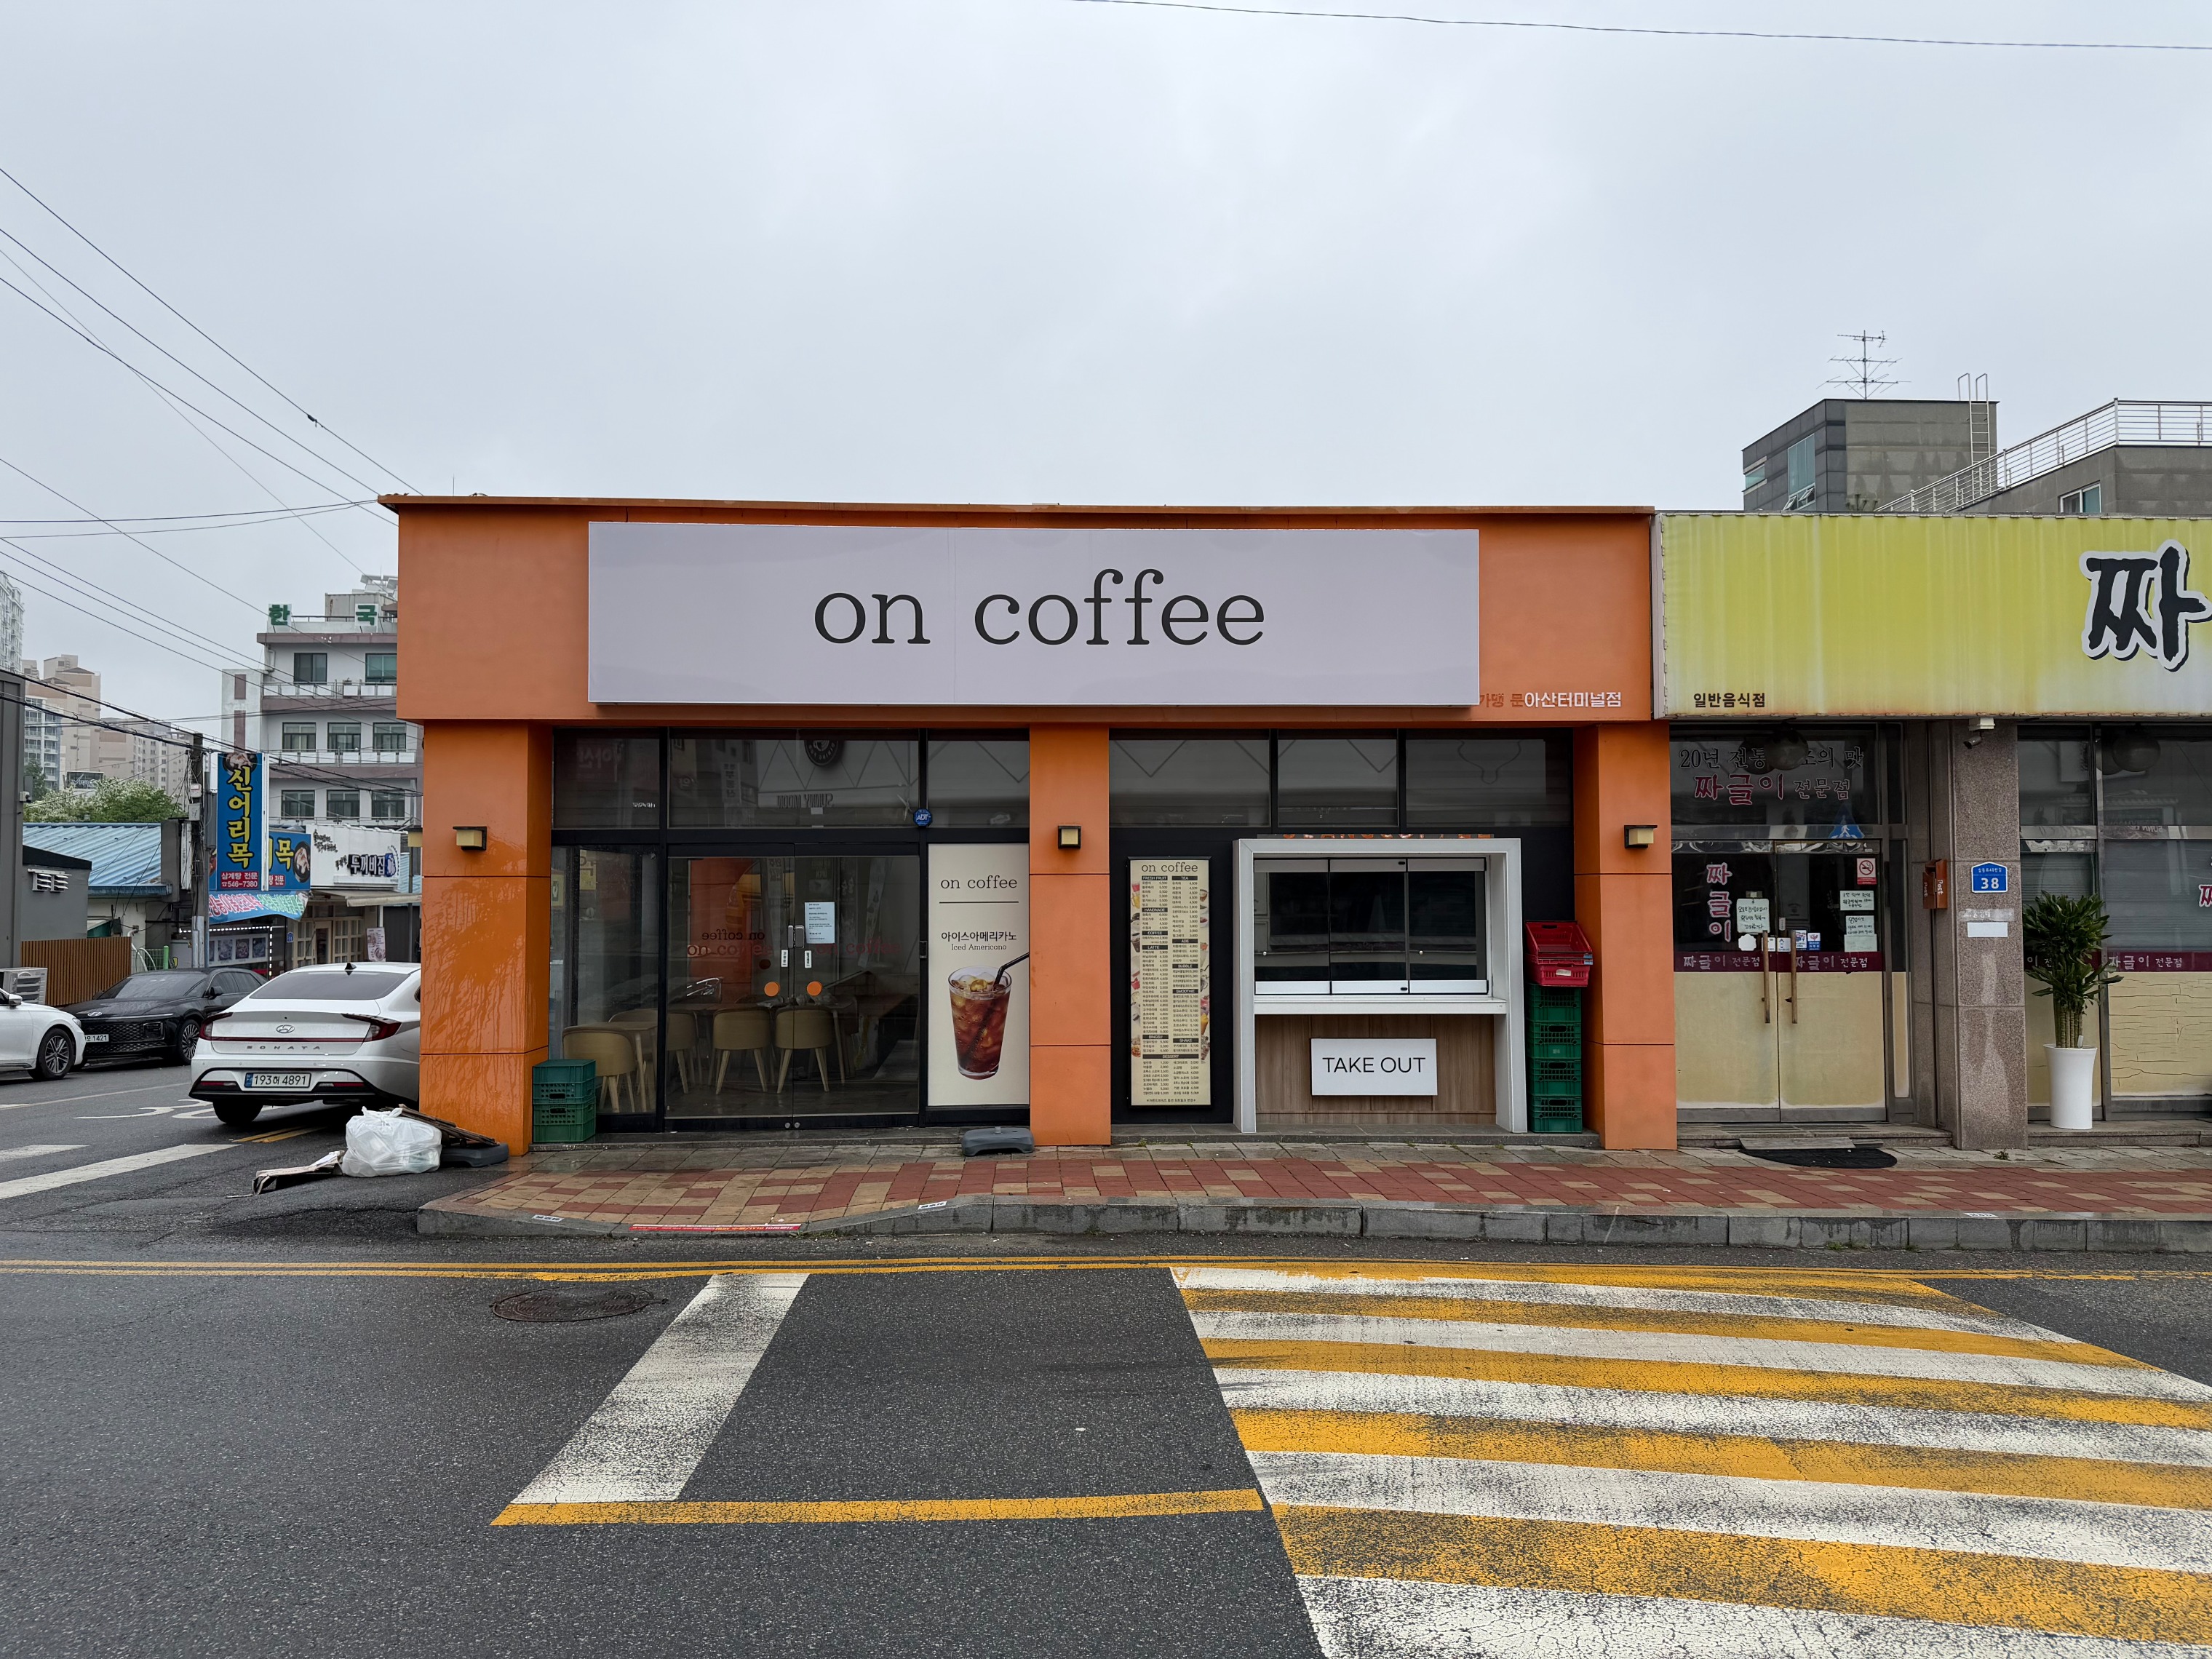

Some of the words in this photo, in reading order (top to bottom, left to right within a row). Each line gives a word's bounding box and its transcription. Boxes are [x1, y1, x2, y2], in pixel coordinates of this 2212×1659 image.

[268, 604, 290, 626] 한
[355, 605, 377, 626] 국
[813, 590, 931, 645] on
[974, 568, 1265, 646] coffee
[1524, 692, 1622, 708] 아산터미널점
[1692, 692, 1766, 709] 일반음식점
[1679, 747, 1721, 769] 20년
[1728, 747, 1767, 769] 전통
[1845, 746, 1864, 769] 맛
[1694, 773, 1784, 806] 짜글이
[1794, 778, 1851, 800] 전문점
[226, 765, 255, 870] 신어리목
[349, 854, 385, 875] 두꺼비집
[1141, 864, 1156, 872] on
[1161, 862, 1198, 872] coffee
[221, 872, 242, 880] 삼계탕
[244, 872, 258, 880] 전문
[940, 879, 960, 889] on
[967, 875, 1017, 889] coffee
[1981, 878, 2000, 890] 38
[1706, 862, 1732, 942] 짜글이
[941, 931, 1017, 942] 아이스아메리카노
[1683, 955, 1726, 970] 짜글이
[1732, 956, 1760, 967] 전문점
[1840, 957, 1868, 968] 전문점
[2155, 957, 2183, 968] 전문점
[1322, 1057, 1374, 1073] TAKE
[1380, 1057, 1426, 1073] OUT
[282, 1075, 306, 1085] 4891
